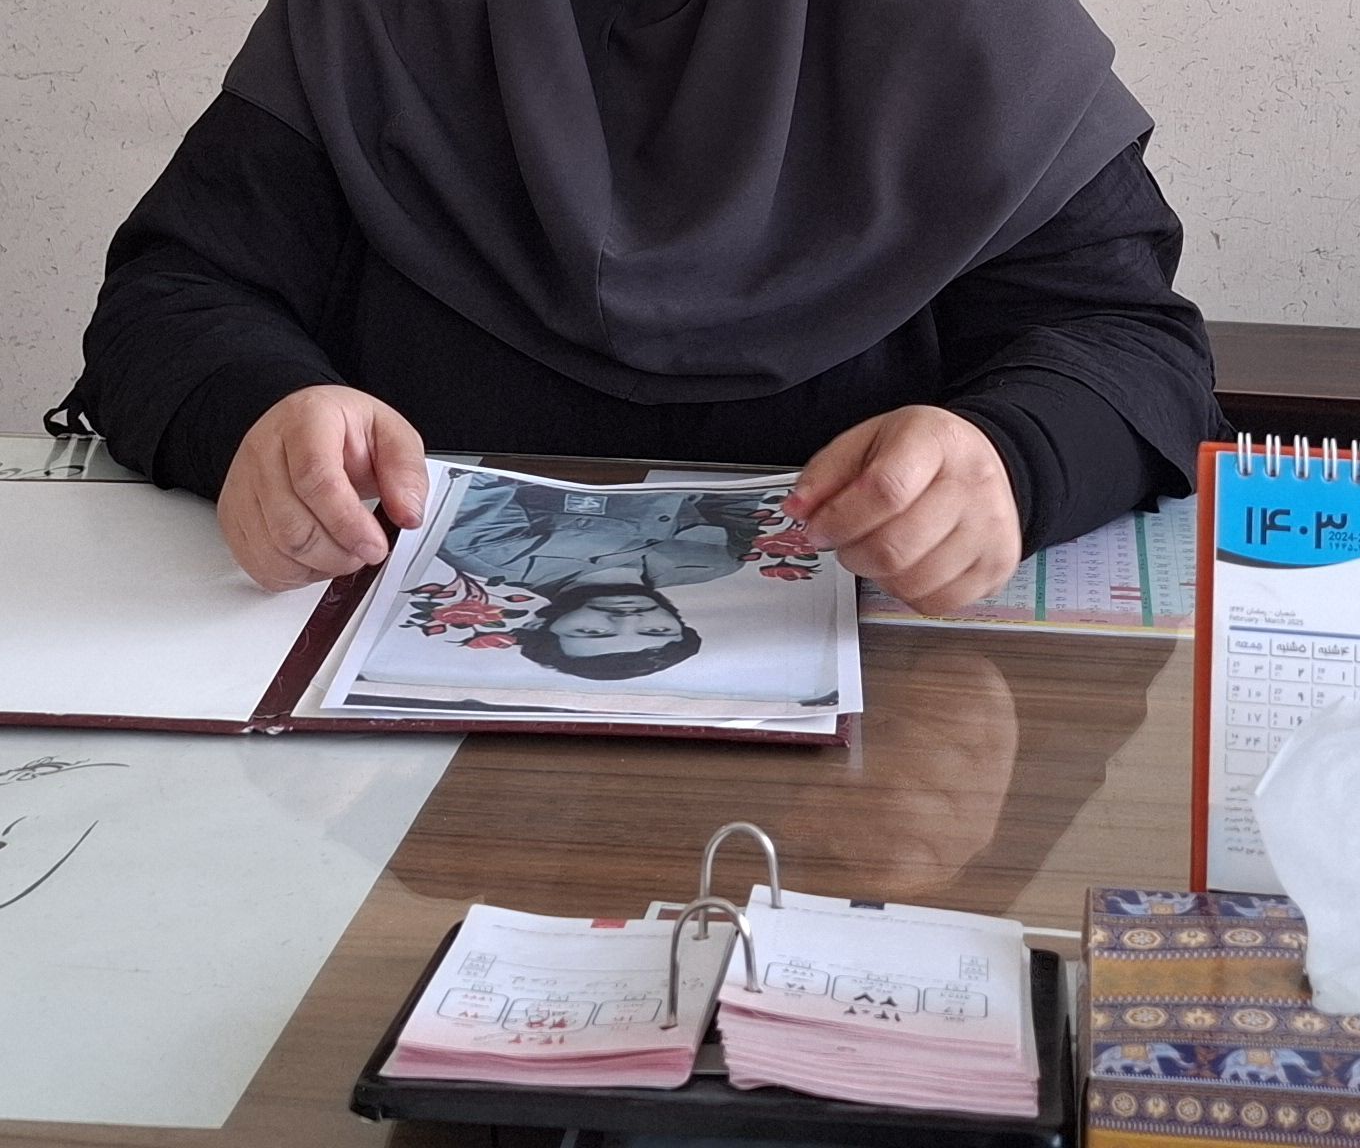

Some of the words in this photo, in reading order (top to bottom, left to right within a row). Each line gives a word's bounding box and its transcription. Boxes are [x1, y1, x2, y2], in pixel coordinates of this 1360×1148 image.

[1246, 506, 1348, 549] ۱۴۰۳
[1229, 614, 1259, 624] February
[1276, 640, 1307, 654] ۵شنبه
[1318, 643, 1349, 657] ۴شنبه
[1248, 689, 1262, 698] ۱۰
[1248, 713, 1262, 722] ۱۷
[1290, 716, 1303, 726] ۱۶
